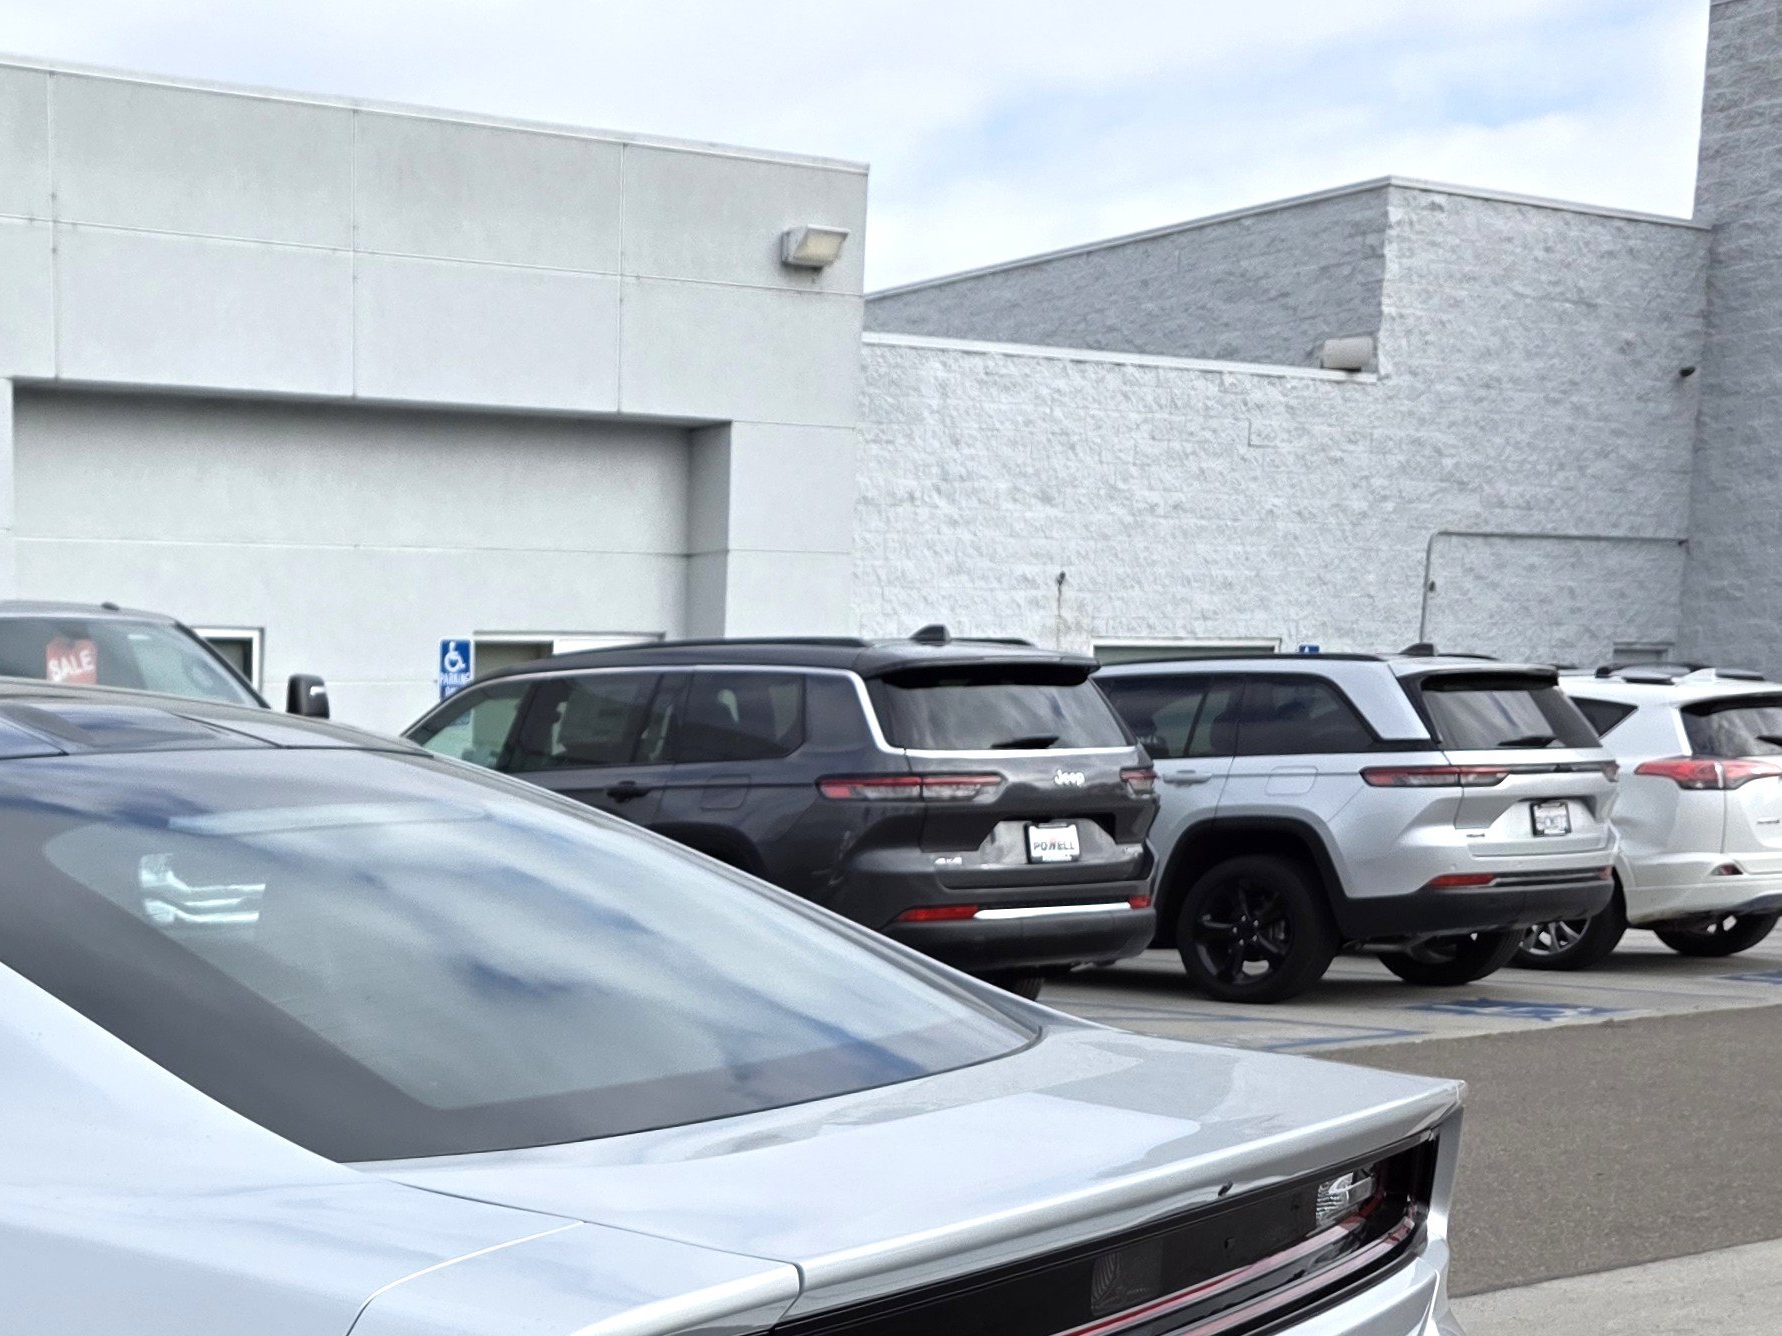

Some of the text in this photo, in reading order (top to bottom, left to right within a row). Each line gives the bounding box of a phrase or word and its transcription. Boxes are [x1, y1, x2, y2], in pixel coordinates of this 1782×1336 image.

[47, 649, 95, 682] SALE
[1054, 769, 1086, 787] Jeep
[1033, 841, 1075, 851] POWELL
